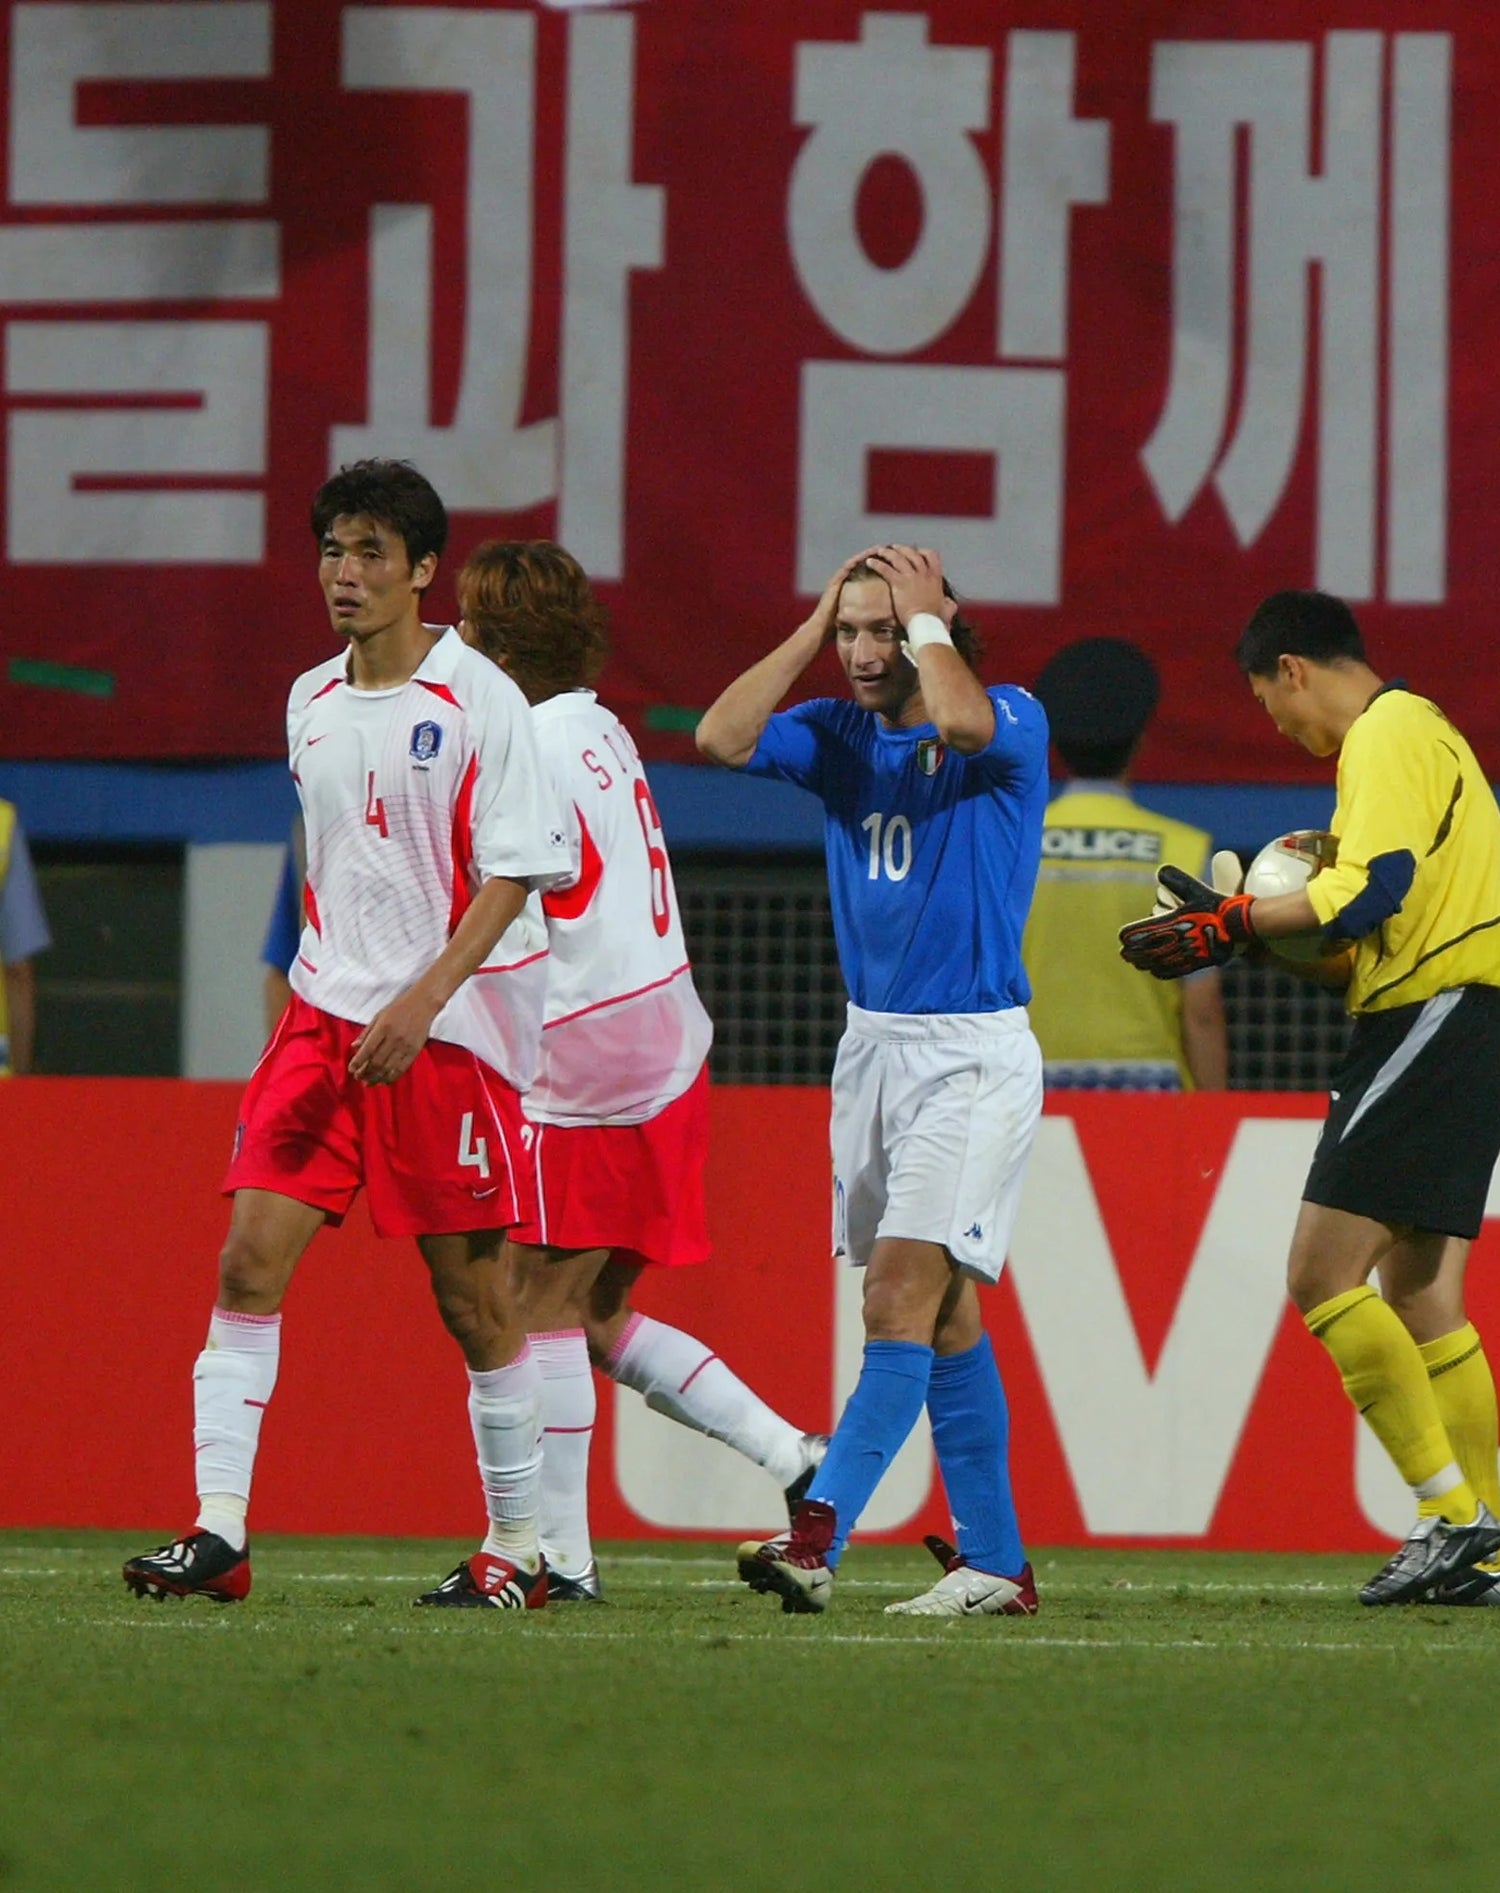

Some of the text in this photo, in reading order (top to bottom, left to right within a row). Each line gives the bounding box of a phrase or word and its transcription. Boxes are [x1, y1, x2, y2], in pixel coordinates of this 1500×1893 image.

[0, 0, 666, 582] 들과
[785, 11, 1454, 607] 함께
[366, 770, 389, 839] 4
[634, 777, 670, 938] 6
[861, 812, 912, 882] 10
[1042, 829, 1161, 863] OLICE
[458, 1111, 490, 1179] 4
